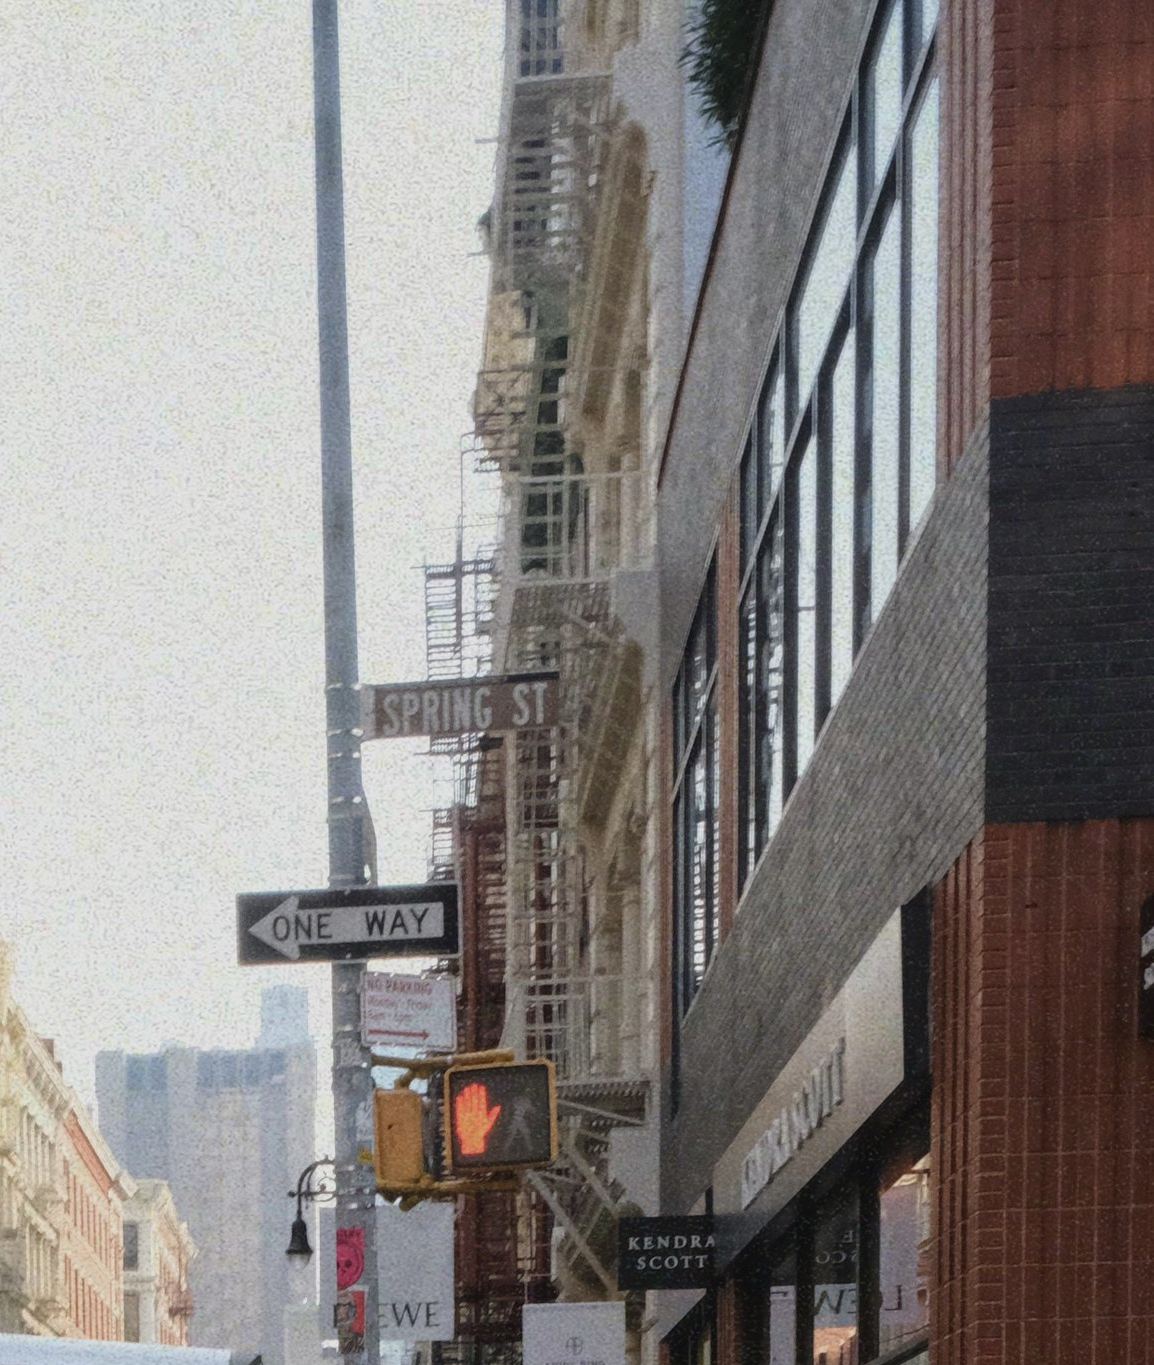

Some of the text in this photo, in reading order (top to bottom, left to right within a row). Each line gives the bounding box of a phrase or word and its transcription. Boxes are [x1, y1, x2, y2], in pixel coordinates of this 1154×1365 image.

[383, 681, 548, 736] SPRING ST
[272, 907, 430, 942] ONE WAY
[628, 1235, 715, 1250] KENDRA
[636, 1254, 708, 1270] SCOTT
